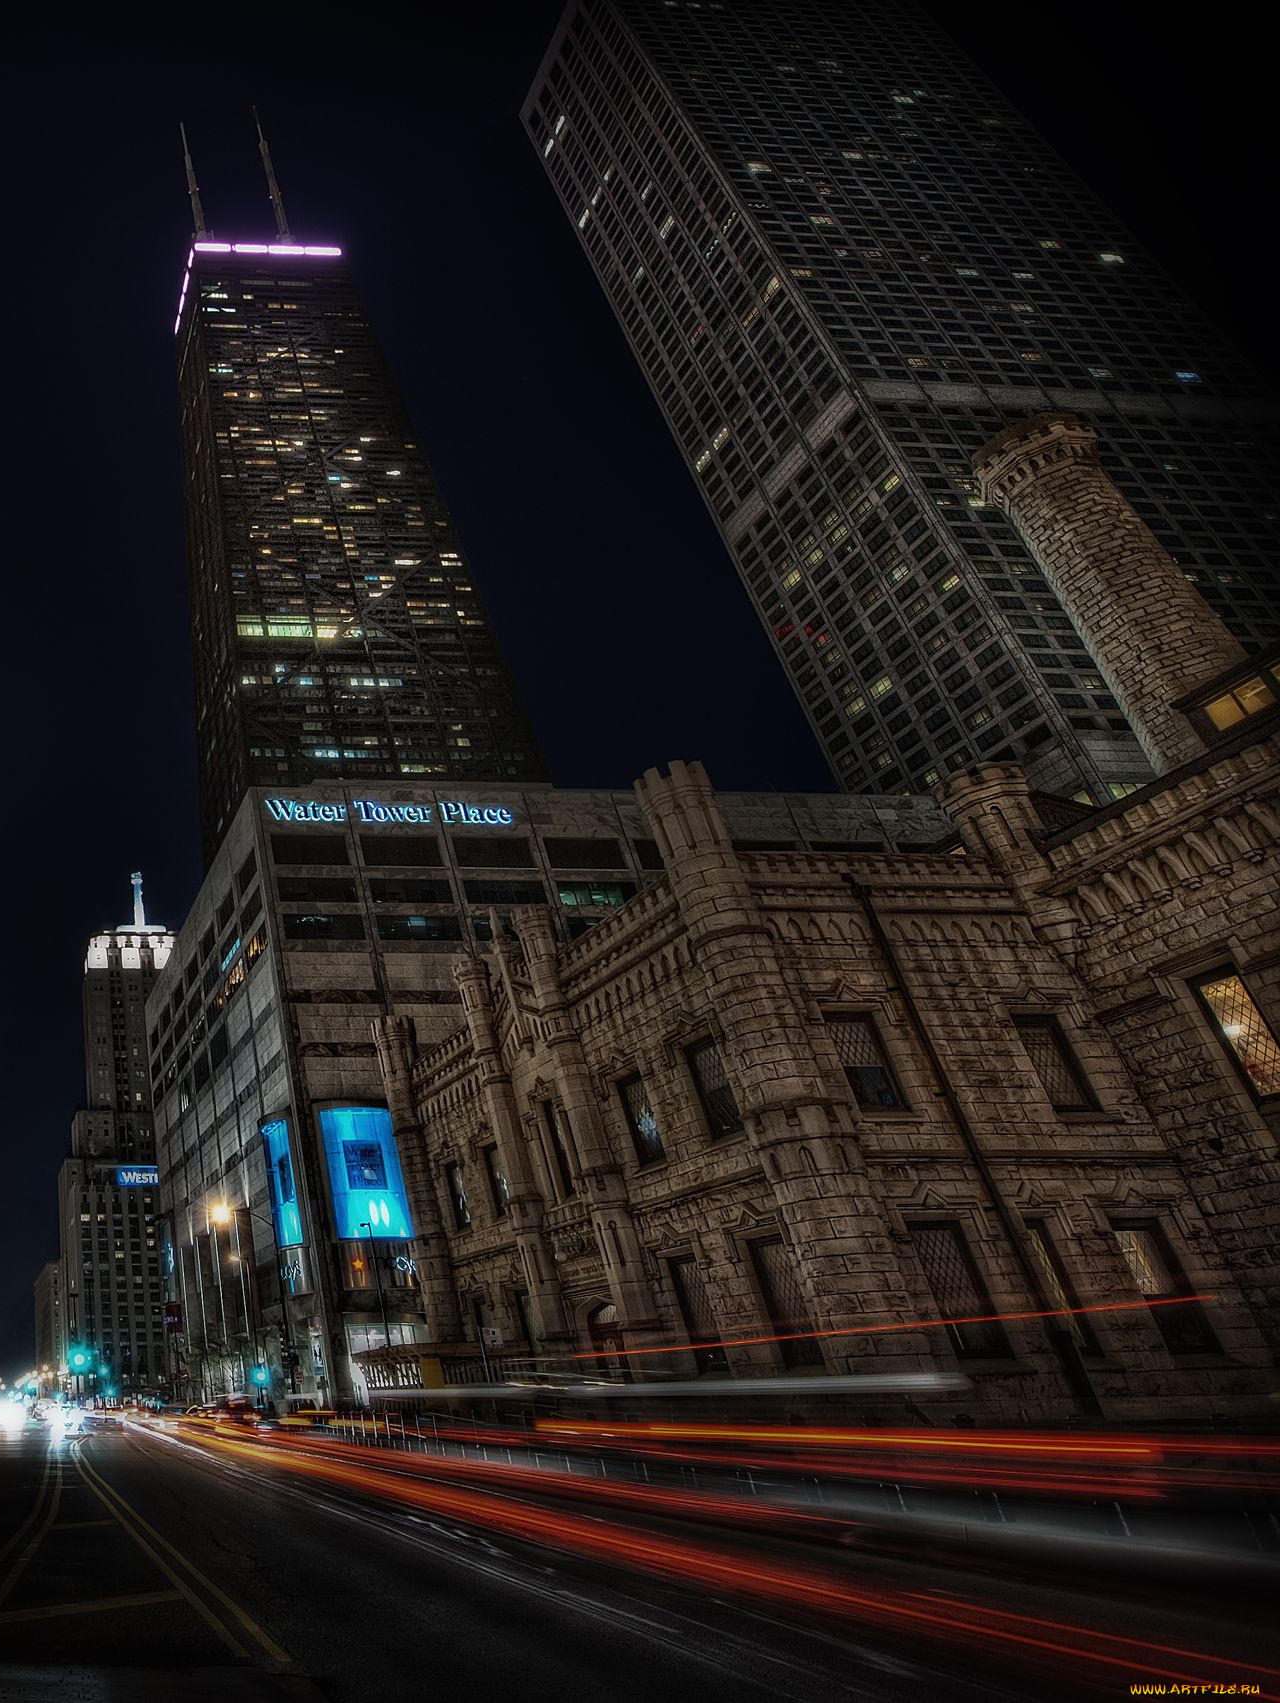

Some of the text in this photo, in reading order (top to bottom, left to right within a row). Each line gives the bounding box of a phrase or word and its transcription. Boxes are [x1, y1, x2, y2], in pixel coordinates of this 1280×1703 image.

[265, 798, 512, 825] Water Tower Place
